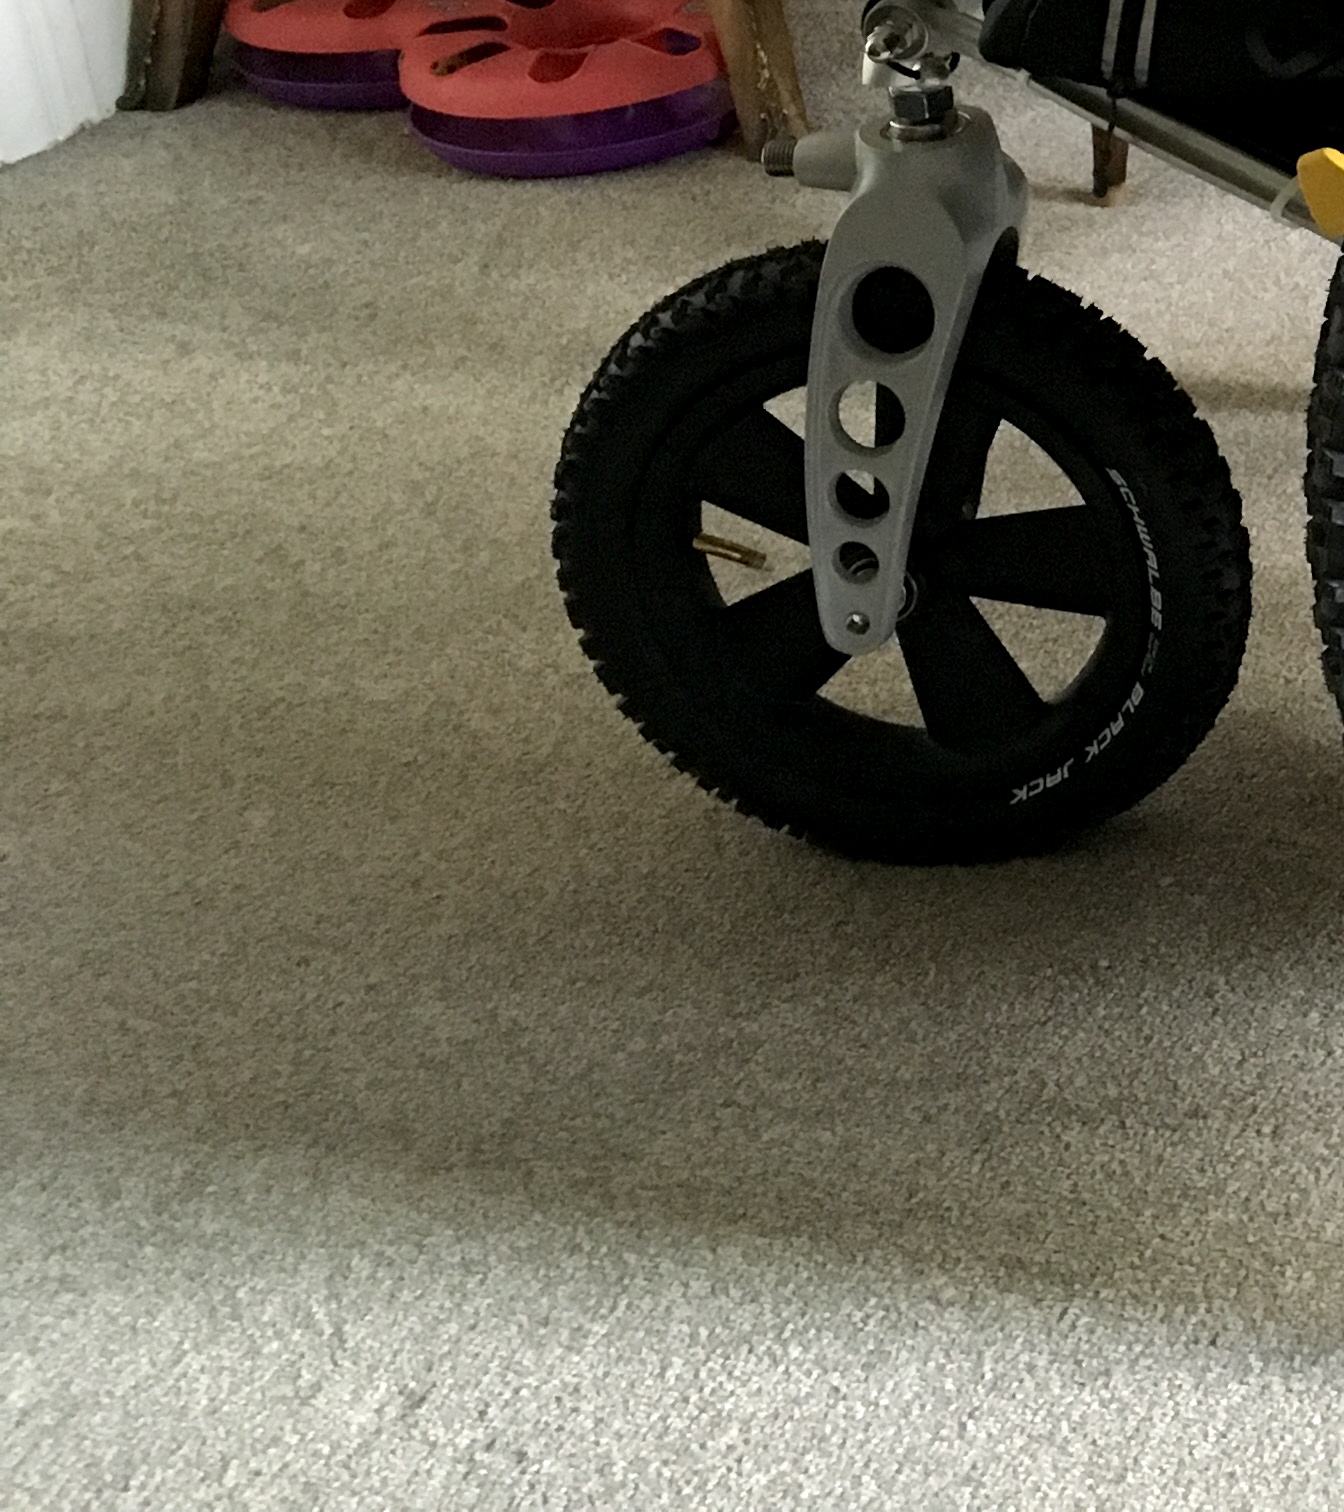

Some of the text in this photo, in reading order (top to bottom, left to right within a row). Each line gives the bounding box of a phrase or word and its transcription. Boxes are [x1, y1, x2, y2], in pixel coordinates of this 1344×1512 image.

[1010, 467, 1162, 805] SCHWALBE BLACK JACK
